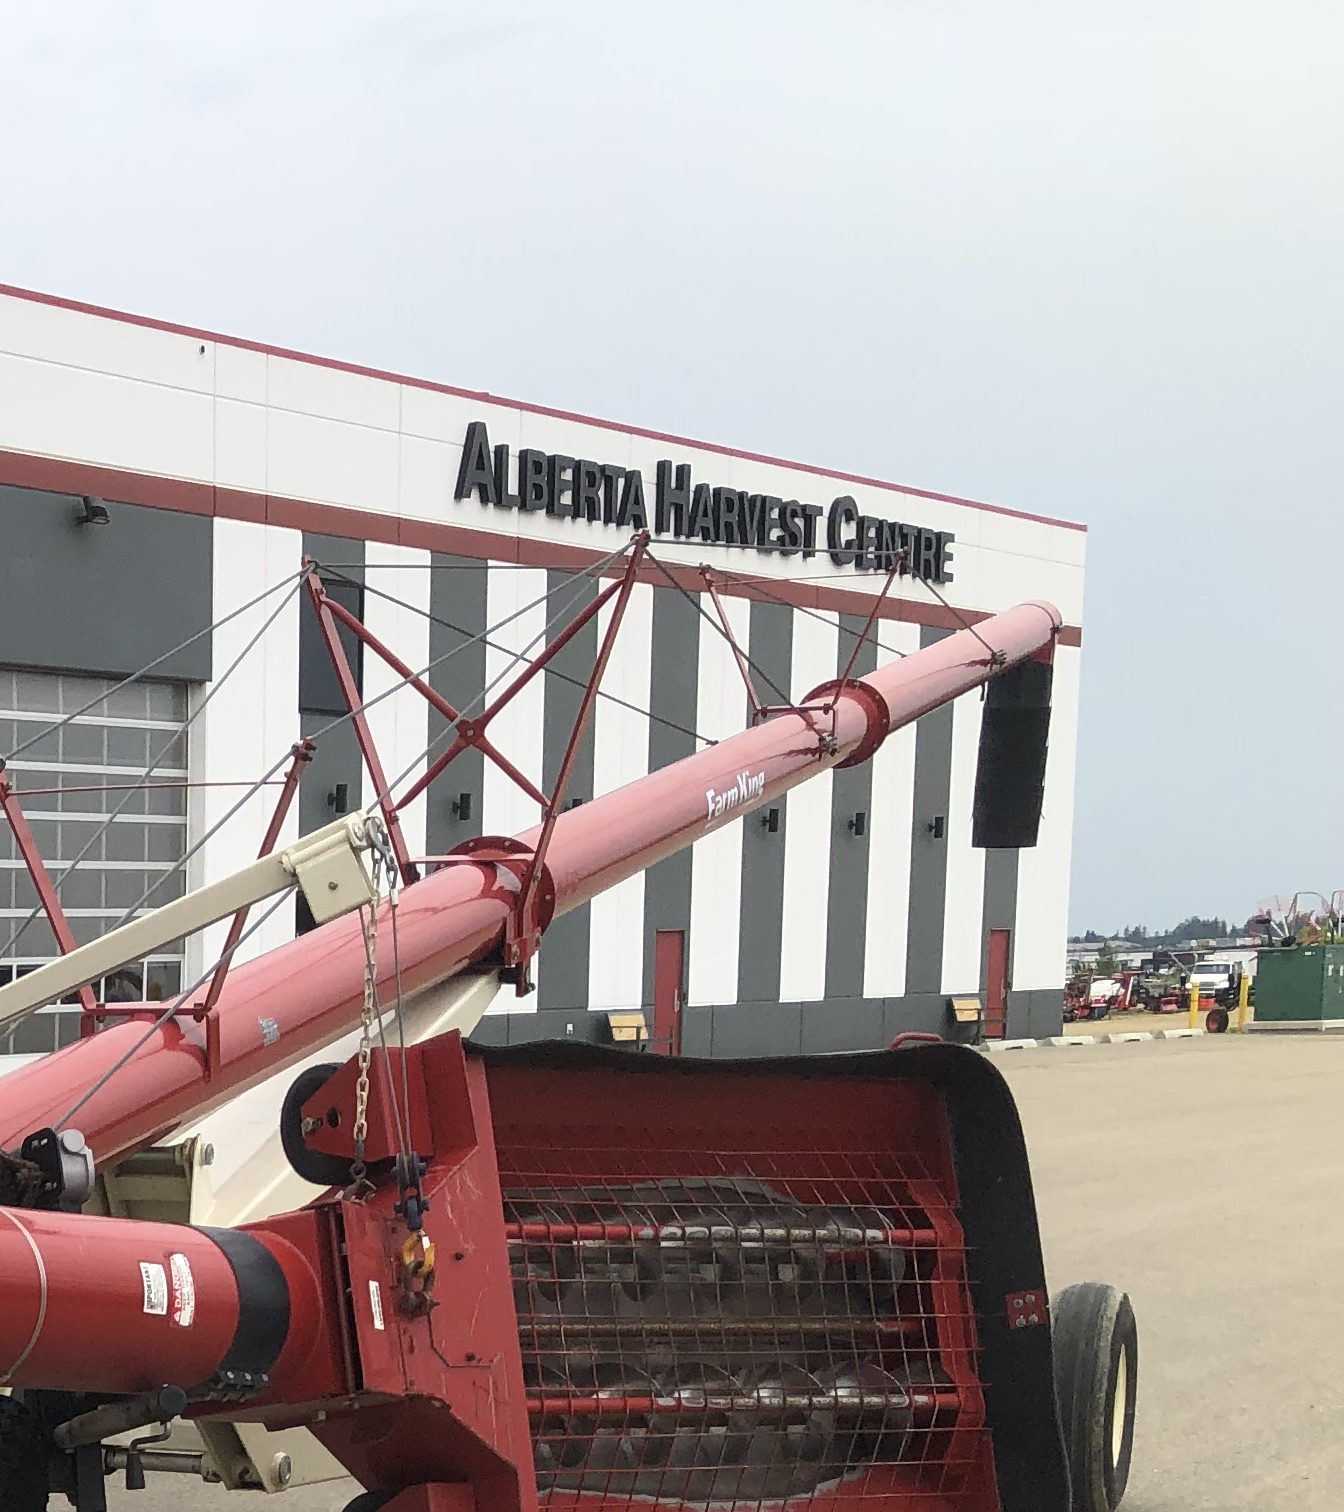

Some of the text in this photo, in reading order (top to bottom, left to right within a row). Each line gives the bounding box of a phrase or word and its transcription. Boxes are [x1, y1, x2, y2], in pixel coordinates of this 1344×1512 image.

[454, 421, 955, 584] ALBERTA HARVEST CENTRE
